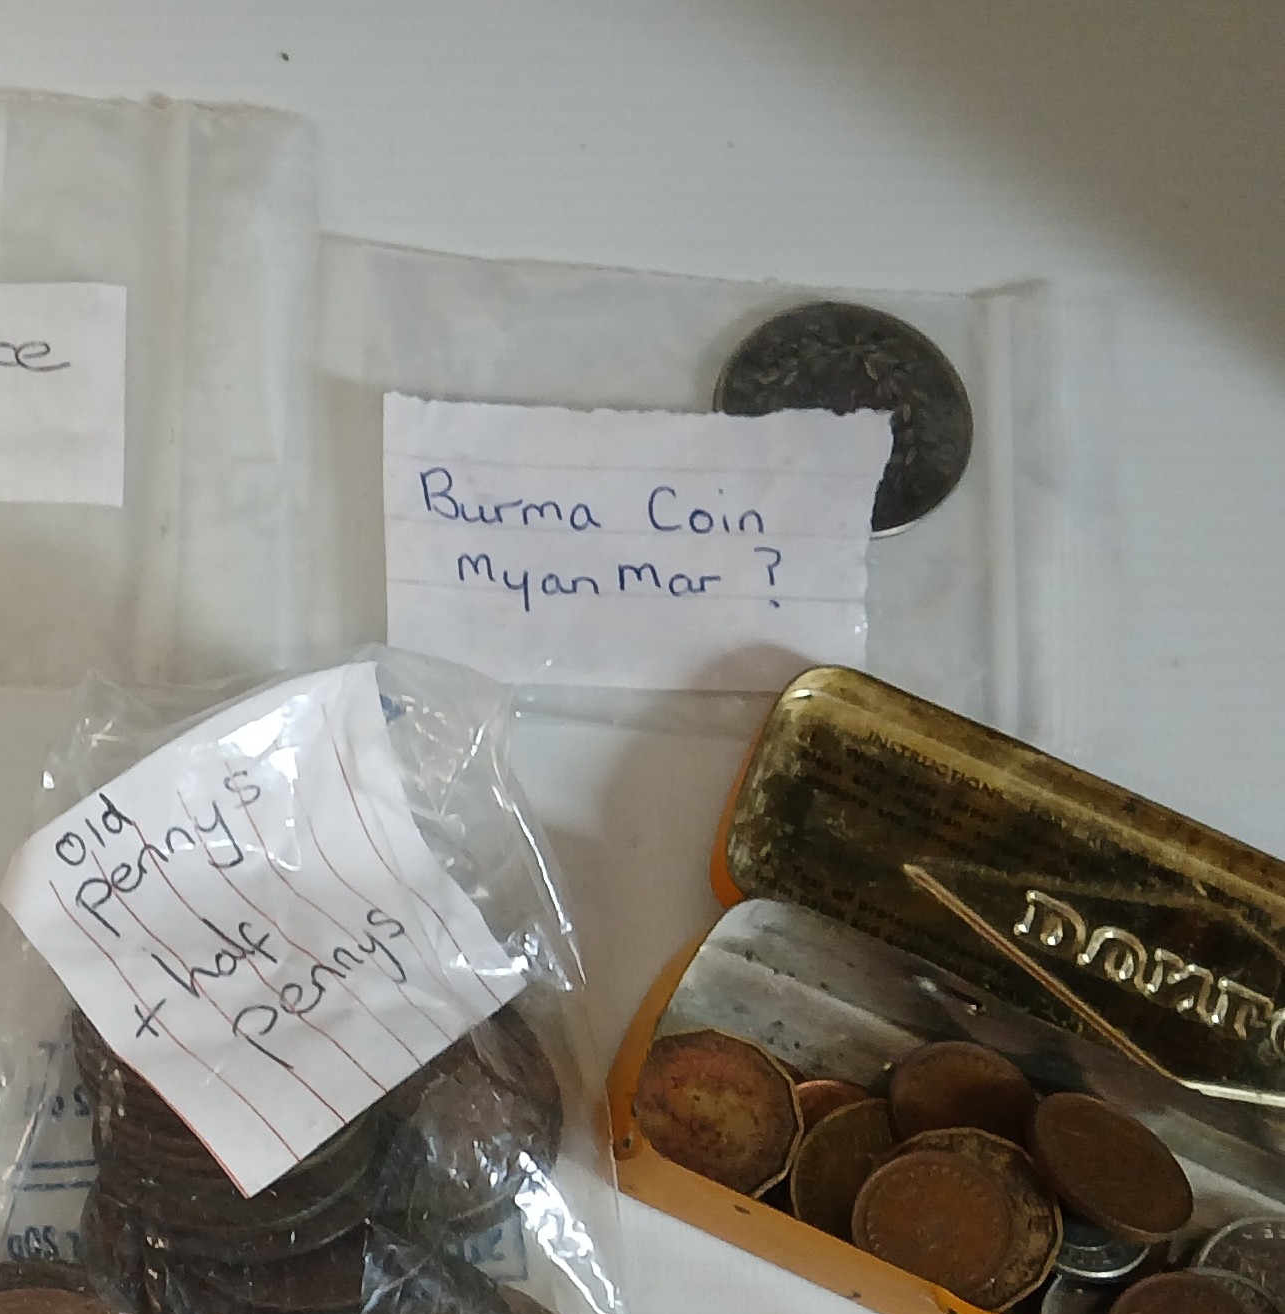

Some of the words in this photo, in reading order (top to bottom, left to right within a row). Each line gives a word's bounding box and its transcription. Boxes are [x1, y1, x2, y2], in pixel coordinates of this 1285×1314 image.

[420, 467, 601, 531] Burma
[648, 486, 765, 533] Coin
[76, 771, 260, 937] pennys
[151, 919, 277, 996] half
[233, 908, 406, 1069] pennys
